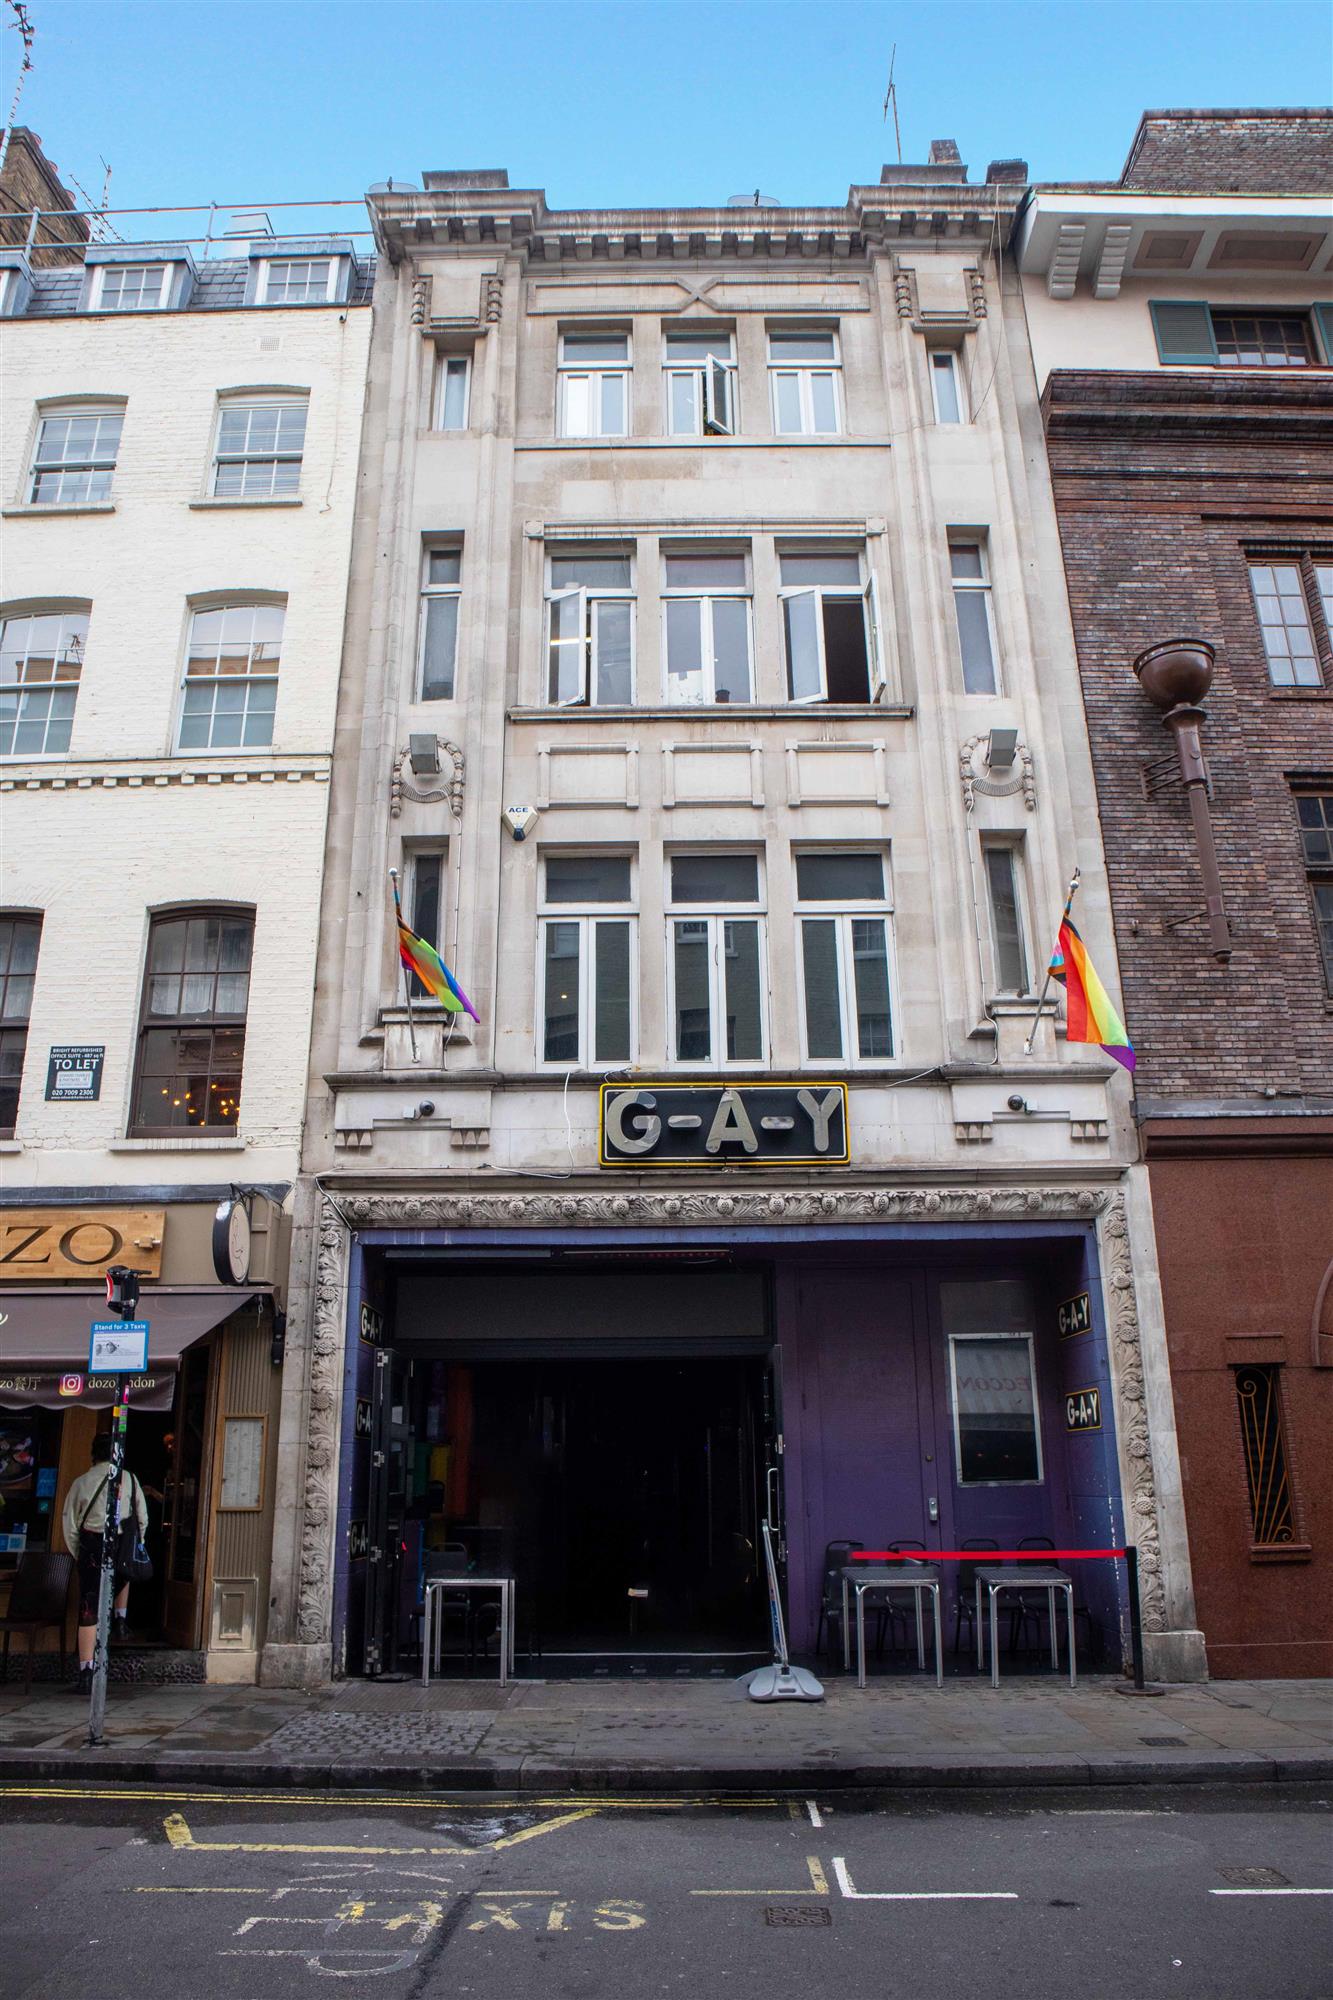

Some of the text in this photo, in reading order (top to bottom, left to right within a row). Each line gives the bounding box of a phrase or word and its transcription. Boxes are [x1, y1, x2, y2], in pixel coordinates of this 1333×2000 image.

[54, 1059, 99, 1070] TO LET
[606, 1088, 843, 1154] G-A-Y
[0, 1223, 123, 1265] ZO
[1059, 1296, 1088, 1334] G-A-Y
[1067, 1393, 1098, 1425] G-A-Y
